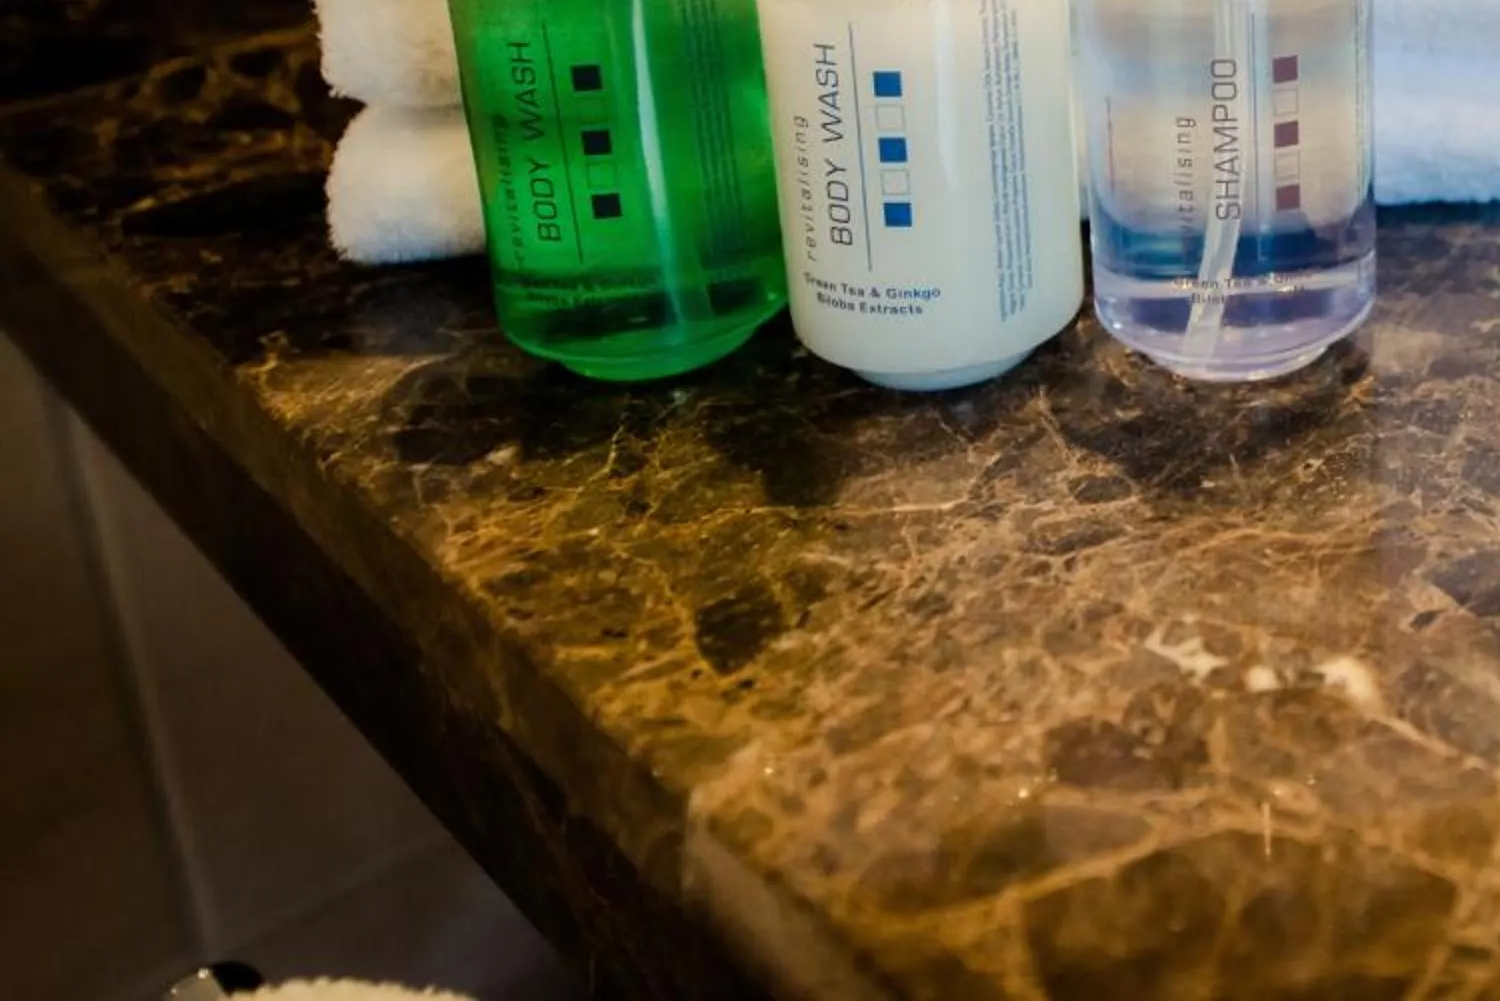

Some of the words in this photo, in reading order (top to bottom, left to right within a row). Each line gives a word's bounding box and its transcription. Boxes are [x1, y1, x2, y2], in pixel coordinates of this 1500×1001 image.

[506, 41, 545, 142] WASH
[814, 43, 844, 143] WASH
[1210, 57, 1241, 221] SHAMPOO
[529, 156, 561, 242] BODY
[793, 115, 818, 263] revitalising
[825, 157, 852, 246] BODY
[804, 271, 837, 292] Green
[840, 282, 865, 297] Tea
[869, 286, 881, 299] &
[885, 286, 941, 302] Ginkgo
[859, 300, 924, 315] Extracts
